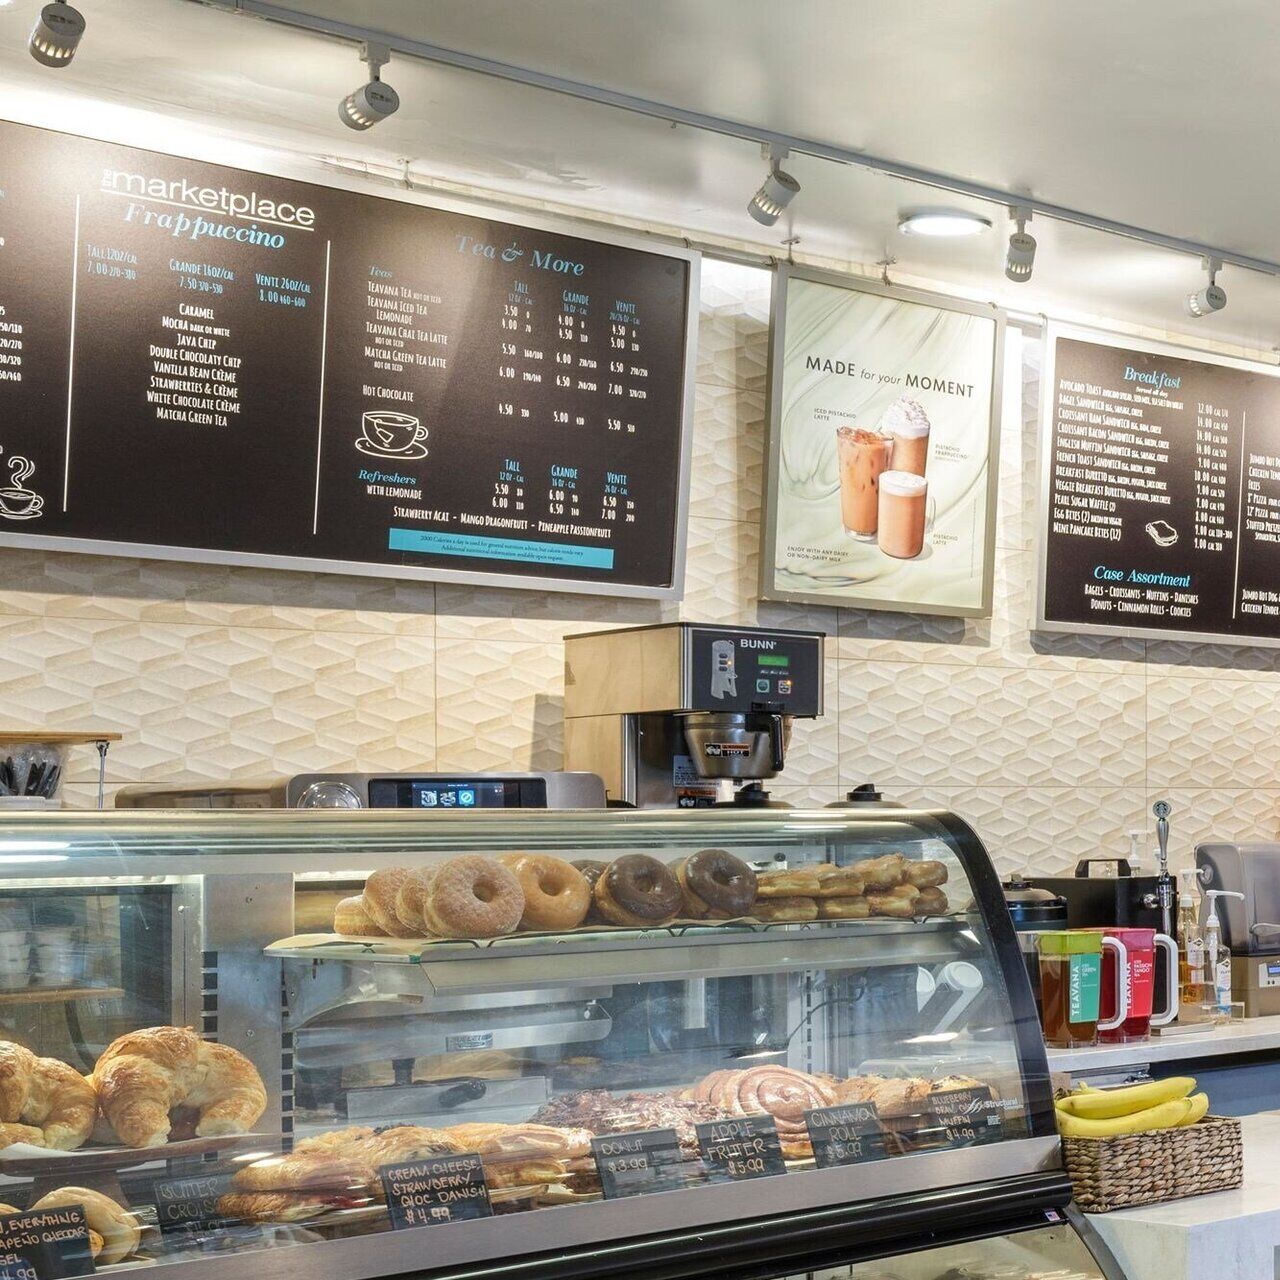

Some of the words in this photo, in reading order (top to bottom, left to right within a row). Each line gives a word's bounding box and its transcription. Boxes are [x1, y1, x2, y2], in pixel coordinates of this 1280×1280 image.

[112, 170, 315, 226] marketplace
[124, 202, 285, 250] Frappuccino
[456, 233, 496, 260] Tea
[501, 241, 524, 262] &
[529, 250, 584, 276] More
[255, 274, 279, 288] VENTI
[179, 303, 215, 320] CARAMEL
[367, 296, 398, 311] TEAVANA
[415, 302, 427, 315] TEA
[162, 316, 188, 331] MOCHA
[376, 308, 412, 325] LEMONADE
[177, 333, 196, 348] JAVA
[198, 336, 216, 350] CHIP
[366, 322, 397, 337] TEAVANA
[417, 329, 429, 342] TEA
[429, 330, 448, 345] LATTE
[150, 345, 178, 360] DOUBLE
[179, 349, 222, 366] CHOCOLATY
[223, 354, 241, 368] CHIP
[364, 346, 391, 361] MATCHA
[392, 350, 414, 364] GREEN
[415, 353, 427, 366] TEA
[428, 355, 447, 369] LATTE
[153, 361, 188, 377] VANILLA
[190, 365, 210, 380] BEAN
[806, 355, 855, 377] MADE
[860, 368, 875, 380] for
[878, 373, 901, 386] your
[905, 373, 974, 398] MOMENT
[1124, 365, 1182, 390] Breakfast
[150, 376, 203, 394] STRAWBERRIES
[362, 384, 376, 397] HOT
[377, 386, 414, 402] CHOCOLATE
[147, 391, 171, 405] WHITE
[173, 394, 214, 411] CHOCOLATE
[157, 407, 186, 422] MATCHA
[188, 411, 213, 426] GREEN
[215, 414, 227, 427] TEA
[505, 458, 520, 472] TALL
[551, 464, 577, 479] GRANDE
[359, 469, 417, 485] Refreshers
[607, 471, 627, 485] VENTI
[366, 484, 385, 497] WITH
[385, 487, 422, 500] LEMONADE
[393, 505, 432, 522] STRAWBERRY
[460, 512, 484, 526] MANGO
[485, 514, 528, 531] DRAGONFRUIT
[538, 521, 569, 535] PINEAPPLE
[570, 522, 611, 539] PASSIONFRUIT
[1093, 565, 1123, 581] Case
[1127, 569, 1191, 588] Assortment
[740, 639, 774, 650] BUNN
[1071, 966, 1080, 1016] TEAVANA
[710, 1121, 756, 1142] APPLE
[830, 1125, 862, 1141] ROLL
